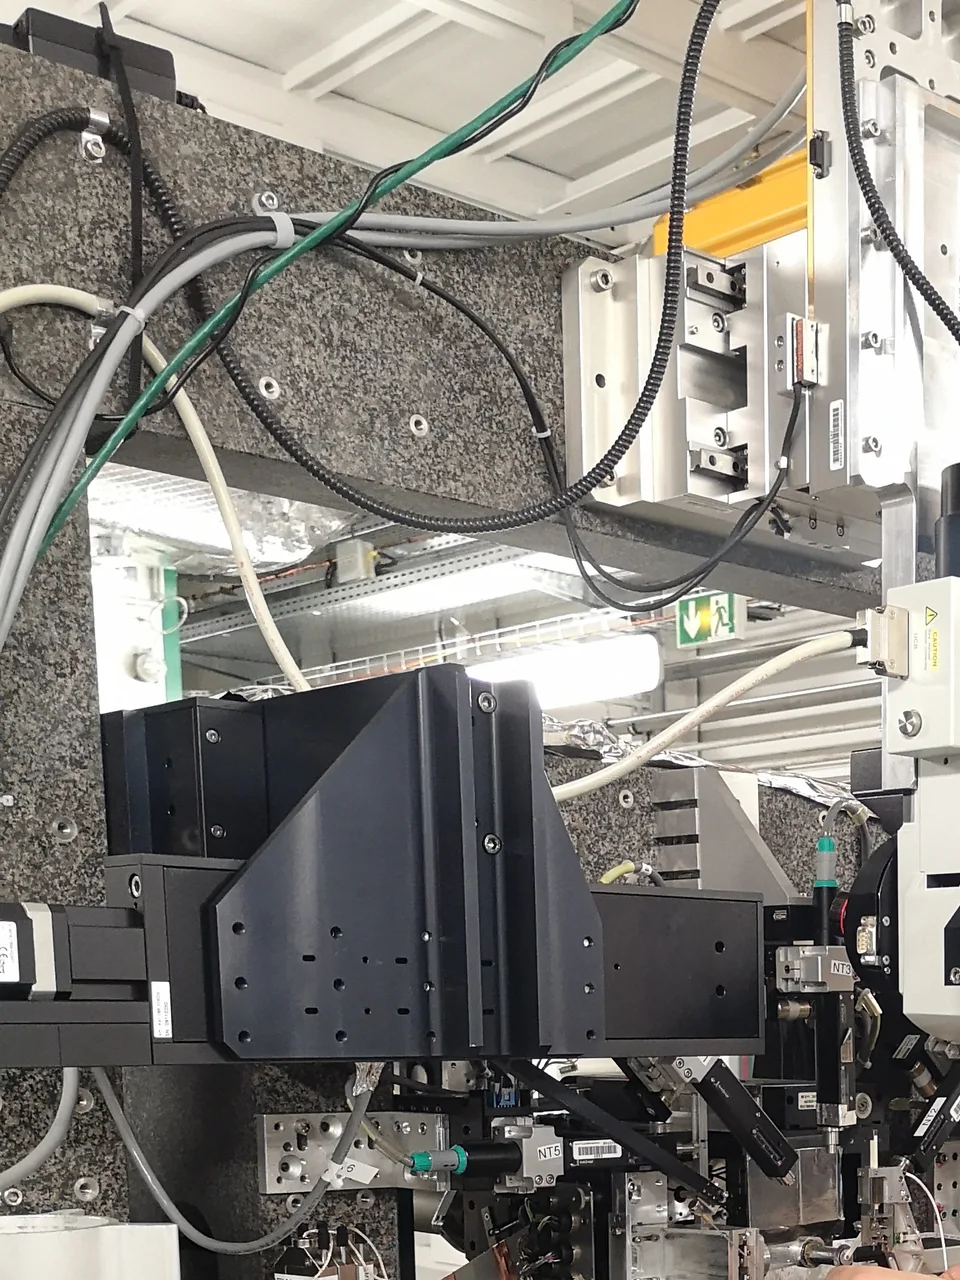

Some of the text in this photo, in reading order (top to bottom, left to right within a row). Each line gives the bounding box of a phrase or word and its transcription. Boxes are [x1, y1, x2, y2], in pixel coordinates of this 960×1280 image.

[833, 962, 851, 975] NT3
[922, 1107, 938, 1127] NT2
[538, 1145, 561, 1160] NT5
